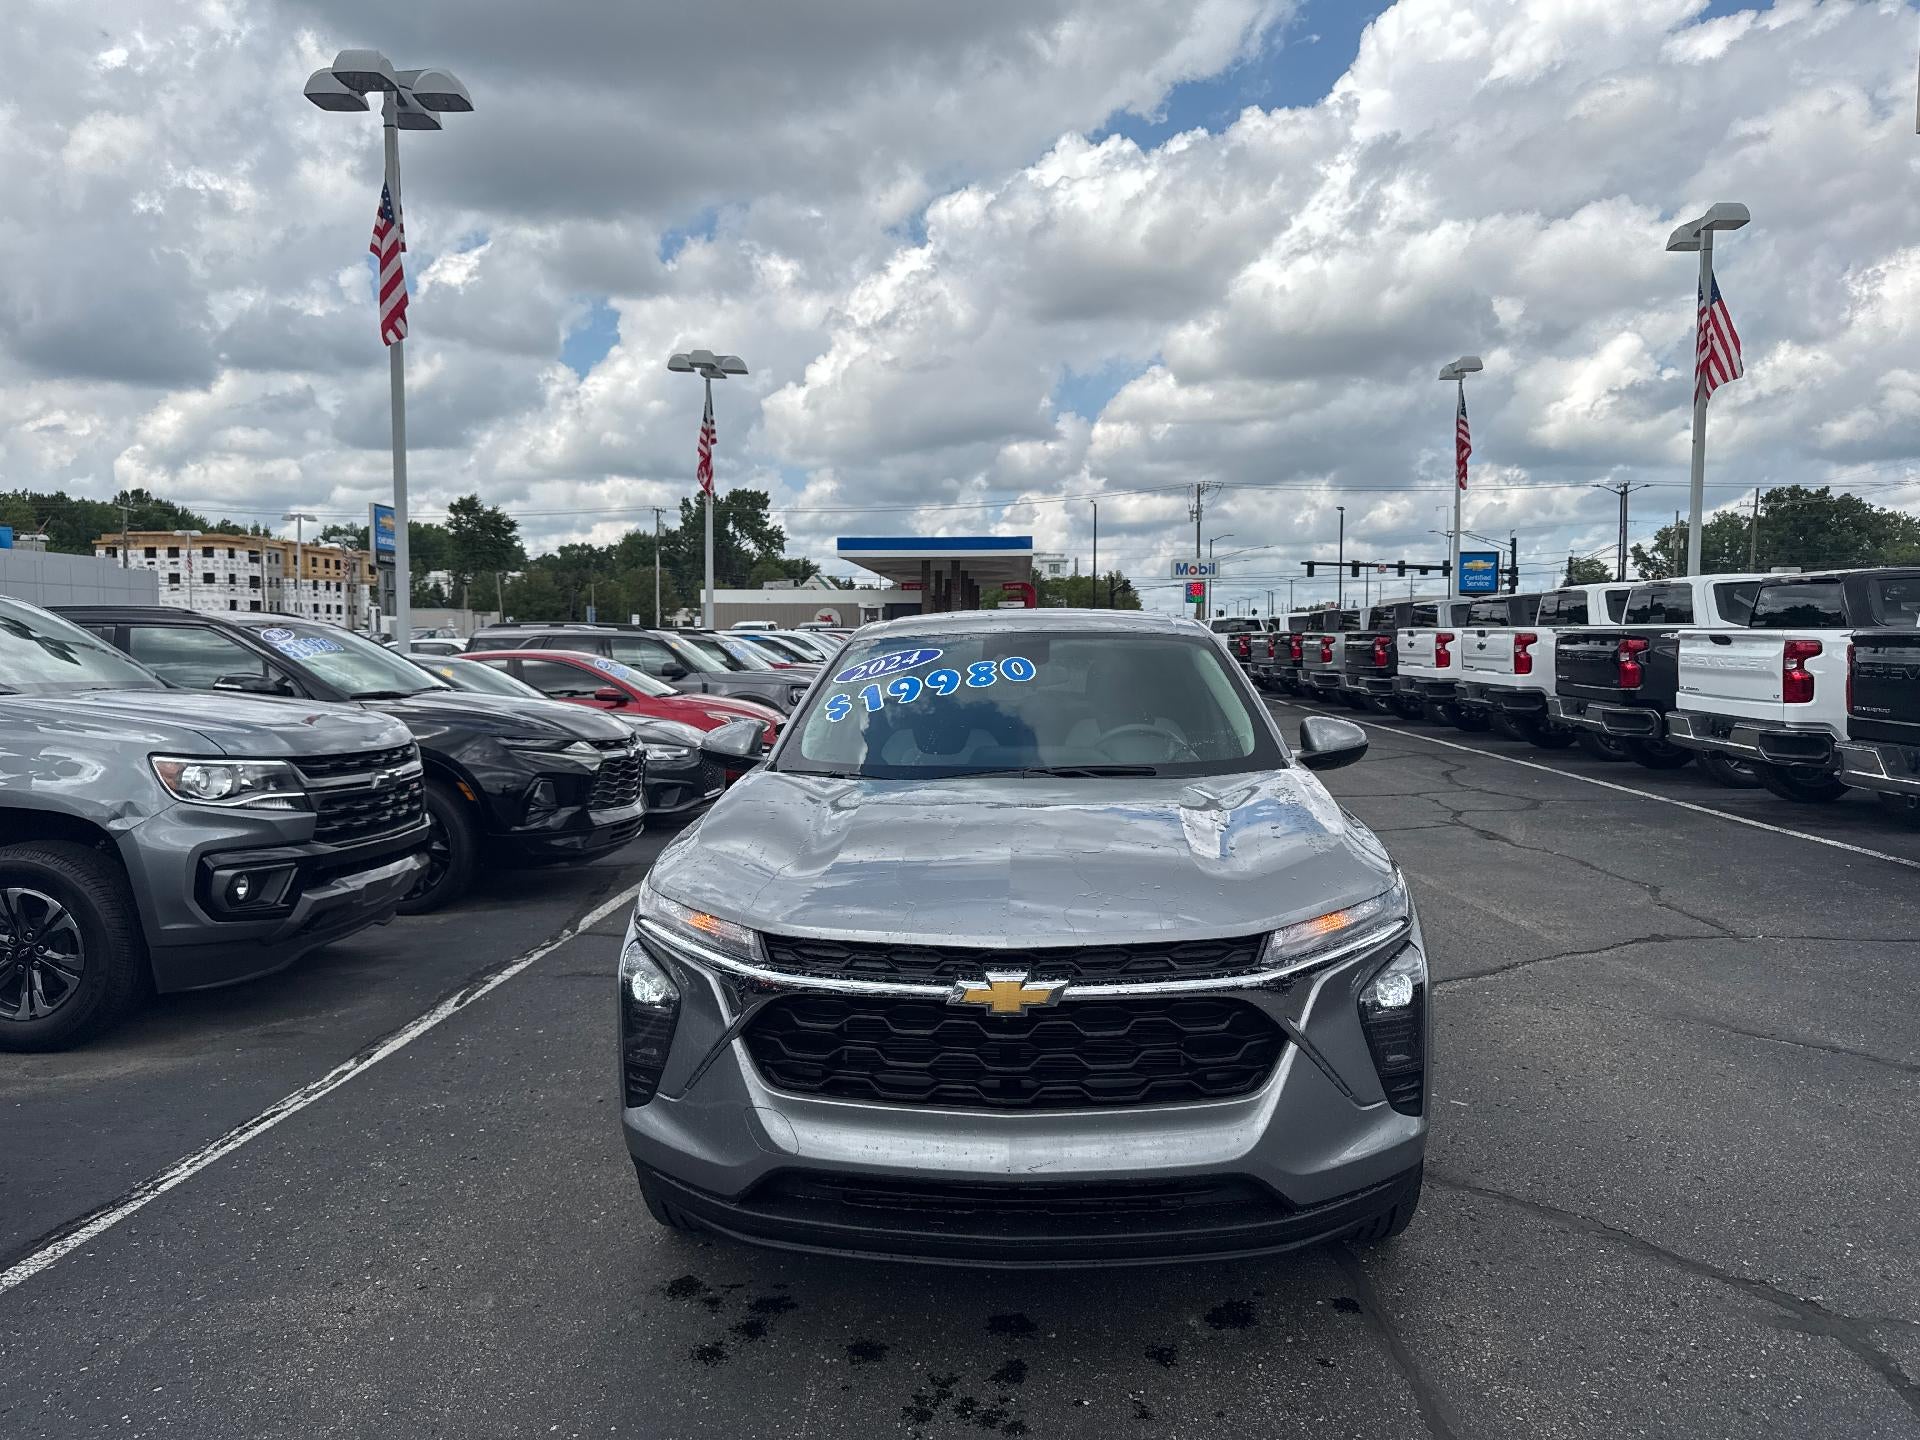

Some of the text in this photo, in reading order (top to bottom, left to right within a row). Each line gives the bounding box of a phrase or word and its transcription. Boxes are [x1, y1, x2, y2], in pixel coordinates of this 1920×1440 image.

[1175, 562, 1216, 576] Mobil
[848, 650, 922, 680] 2024
[824, 656, 1037, 723] $19980
